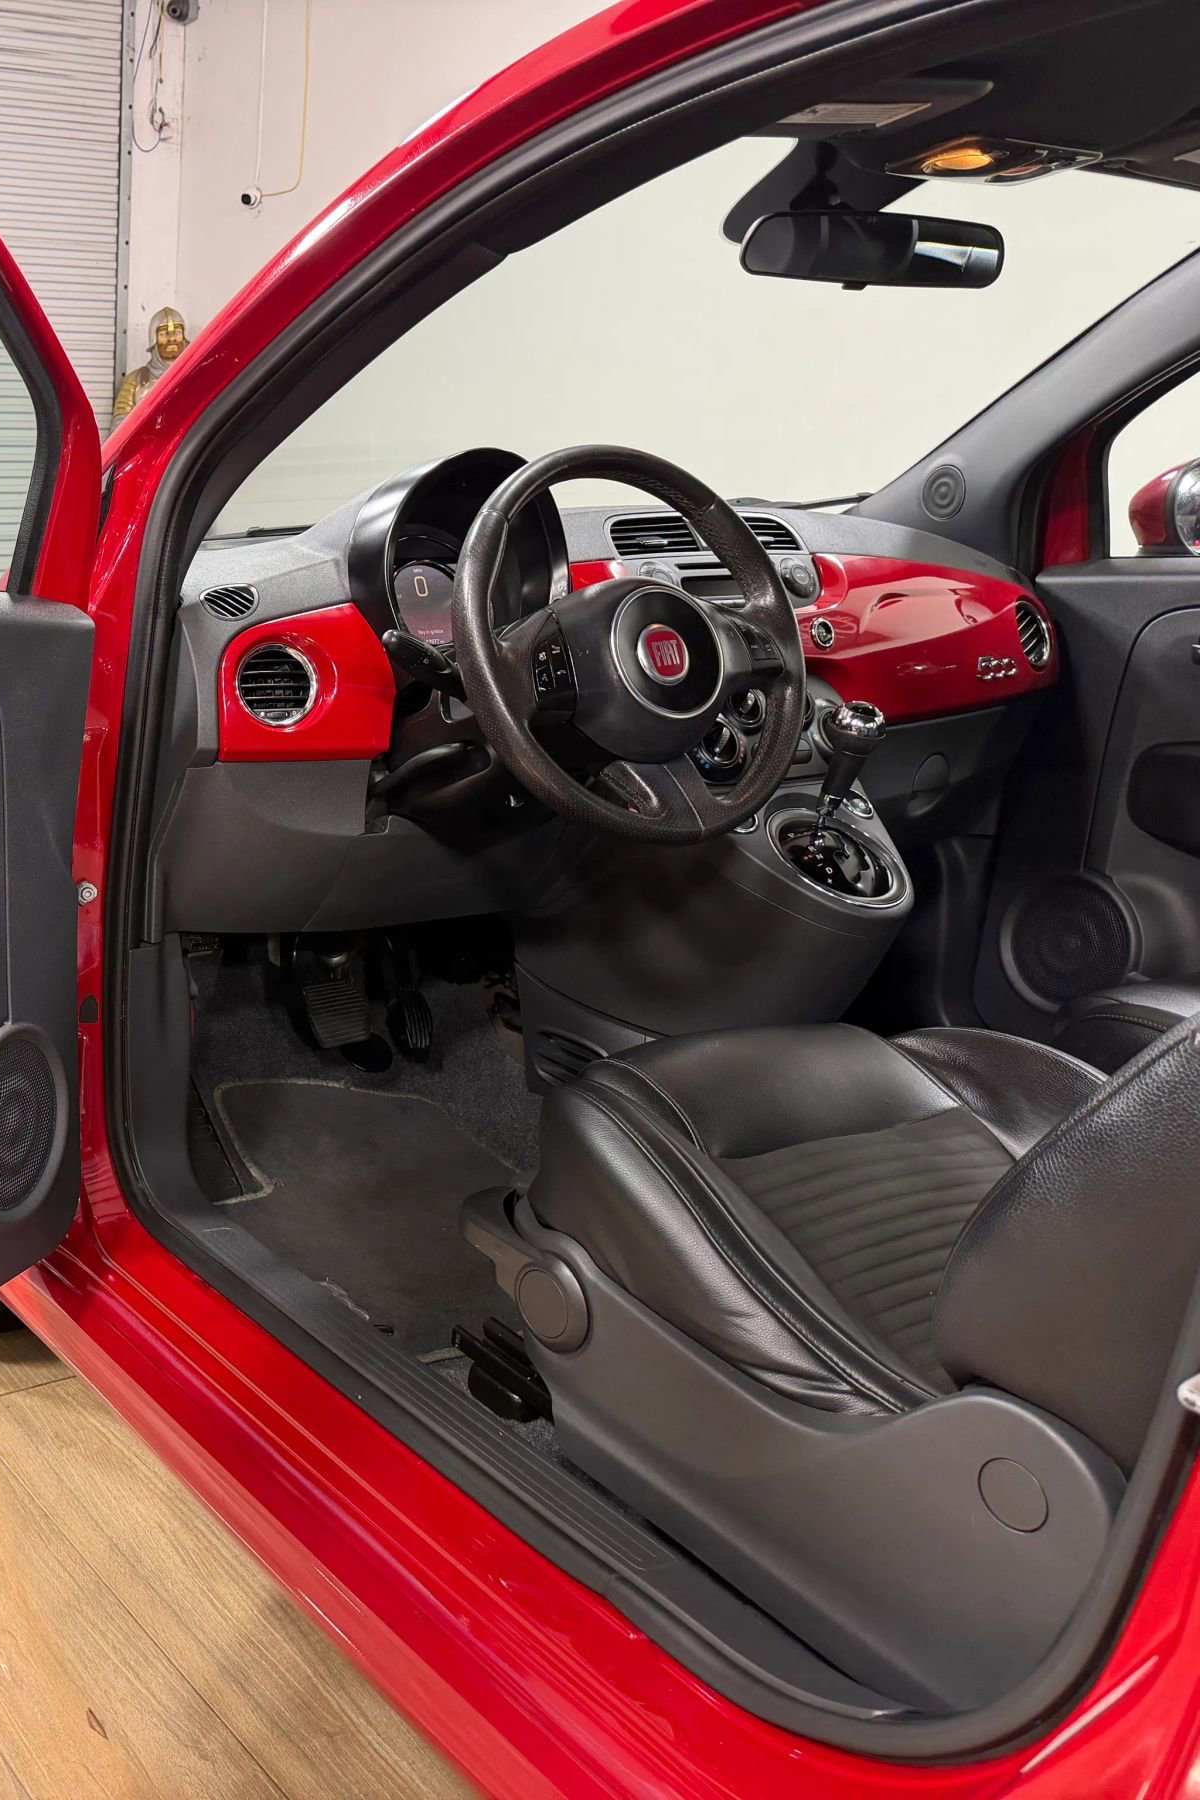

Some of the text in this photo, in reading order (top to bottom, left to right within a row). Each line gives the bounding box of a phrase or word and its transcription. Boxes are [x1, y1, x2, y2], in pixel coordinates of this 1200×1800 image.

[414, 575, 429, 597] 0
[651, 639, 680, 667] FIAT
[976, 656, 1016, 679] 500
